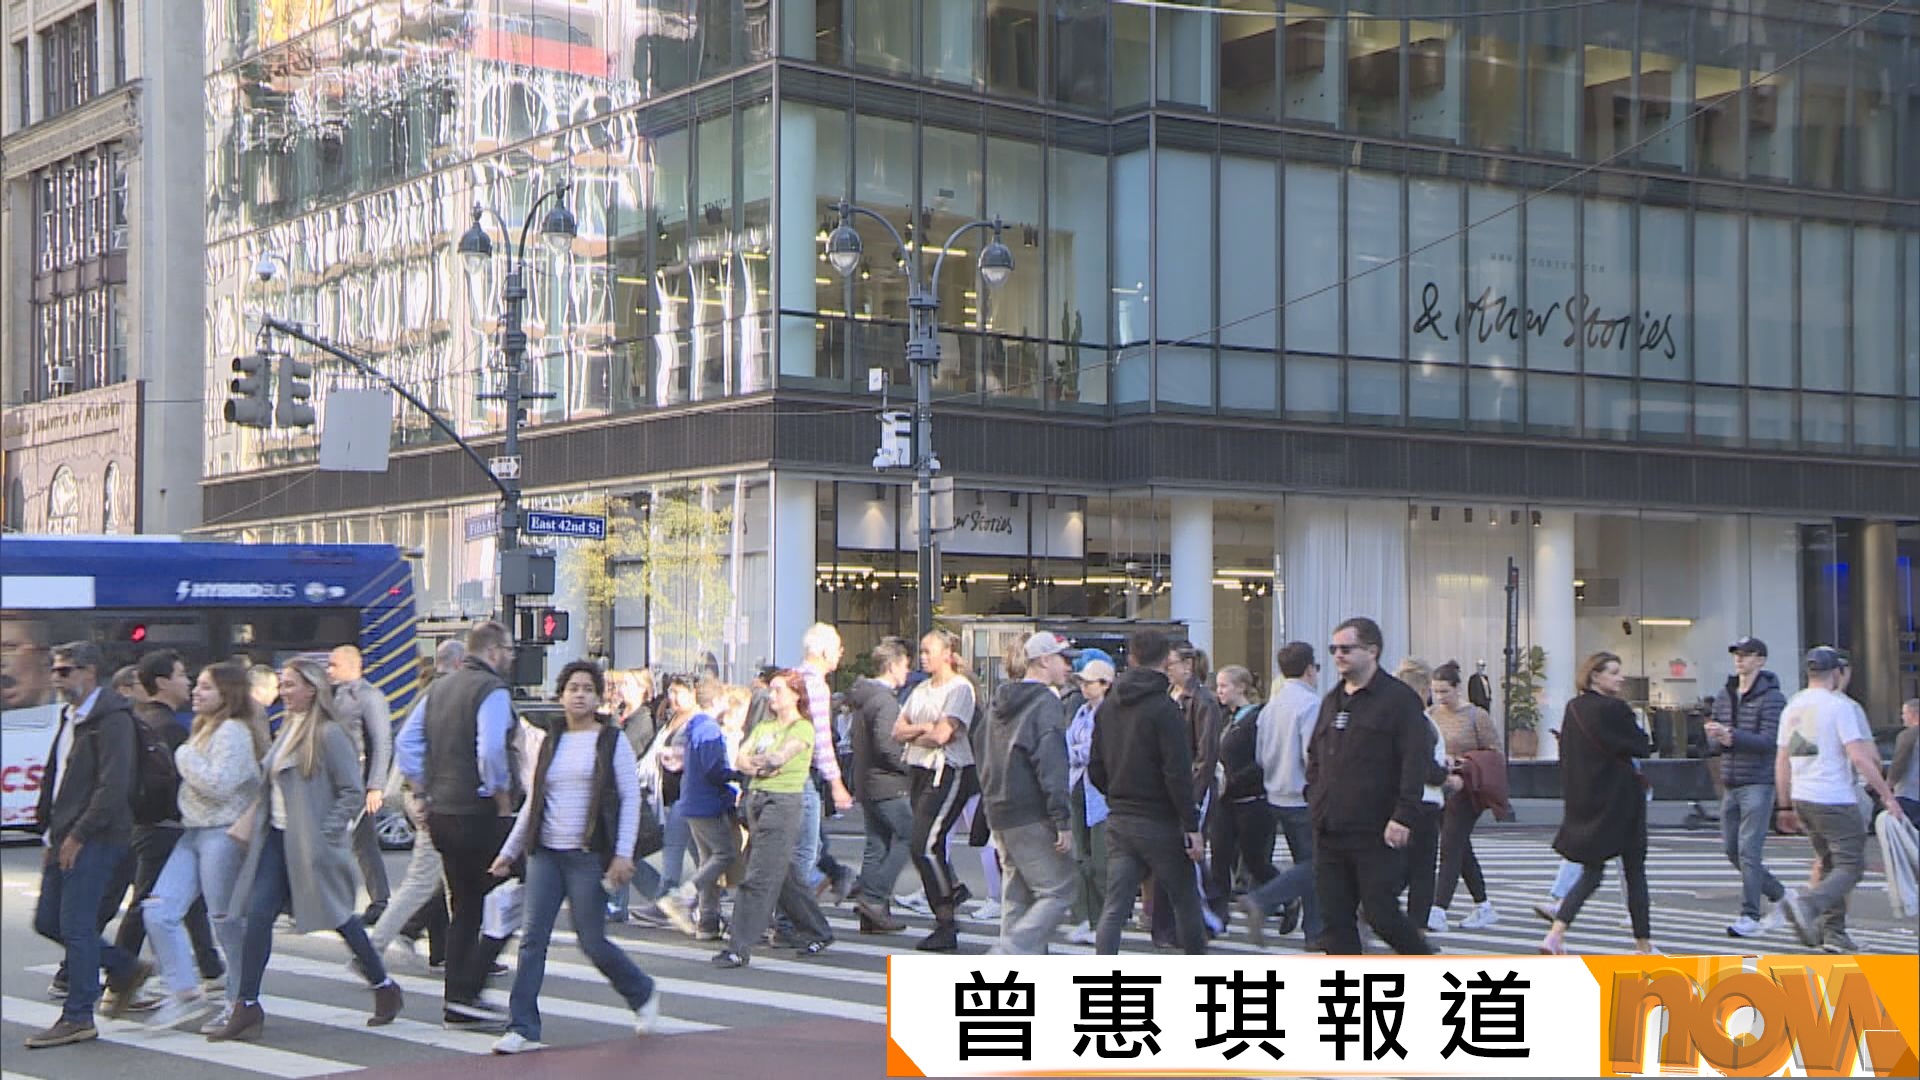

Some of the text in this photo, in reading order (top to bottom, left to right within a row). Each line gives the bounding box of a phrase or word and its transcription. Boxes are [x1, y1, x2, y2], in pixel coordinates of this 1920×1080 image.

[1413, 282, 1449, 341] &
[1563, 293, 1676, 360] Stories
[531, 516, 600, 534] East 42nd St
